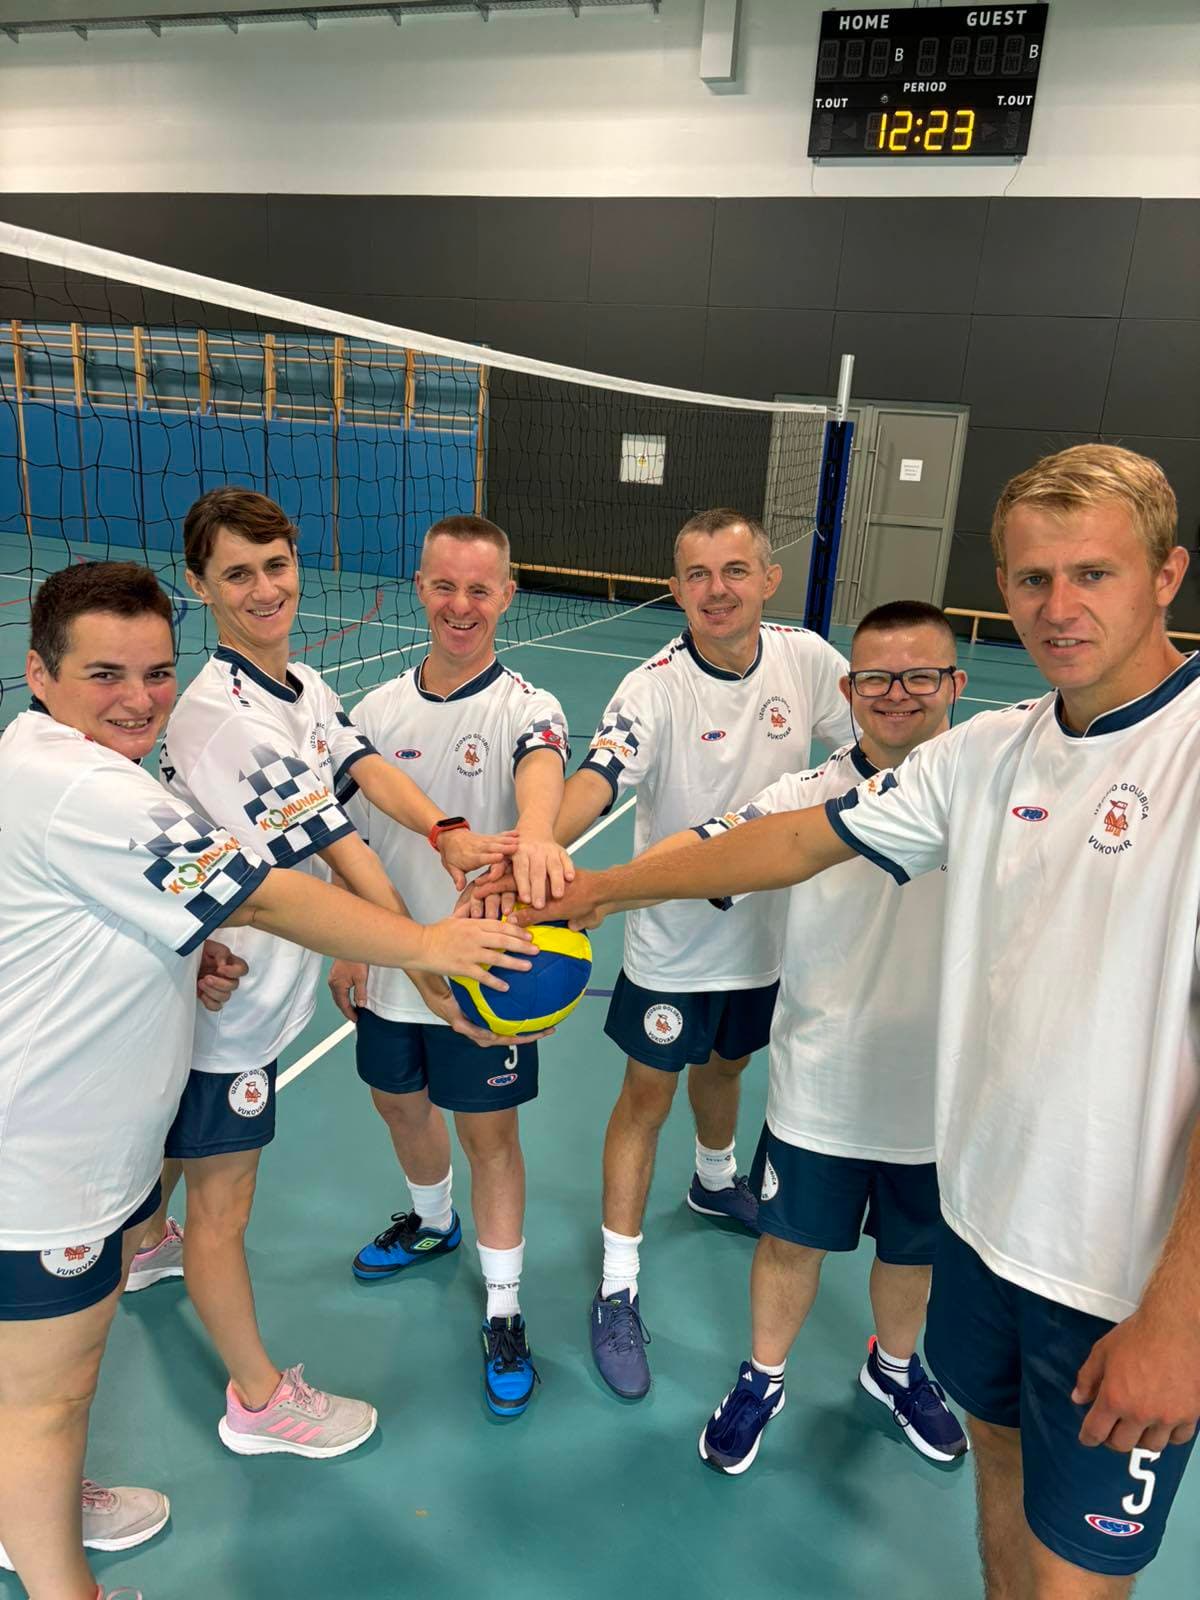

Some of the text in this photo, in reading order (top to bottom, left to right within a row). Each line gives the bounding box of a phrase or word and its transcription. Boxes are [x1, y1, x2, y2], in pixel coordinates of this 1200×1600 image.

[839, 14, 890, 30] HOME
[966, 9, 1028, 26] GUEST
[894, 48, 904, 62] B
[1028, 44, 1040, 59] B
[903, 81, 947, 93] PERIOD
[815, 98, 849, 109] T.OUT
[997, 95, 1033, 106] T.OUT
[878, 110, 976, 151] 12:23
[1120, 782, 1149, 821] GOLUBICA
[1088, 834, 1133, 856] VUKOVAR
[56, 1254, 98, 1276] VUKOVAR
[1121, 1447, 1161, 1515] 5
